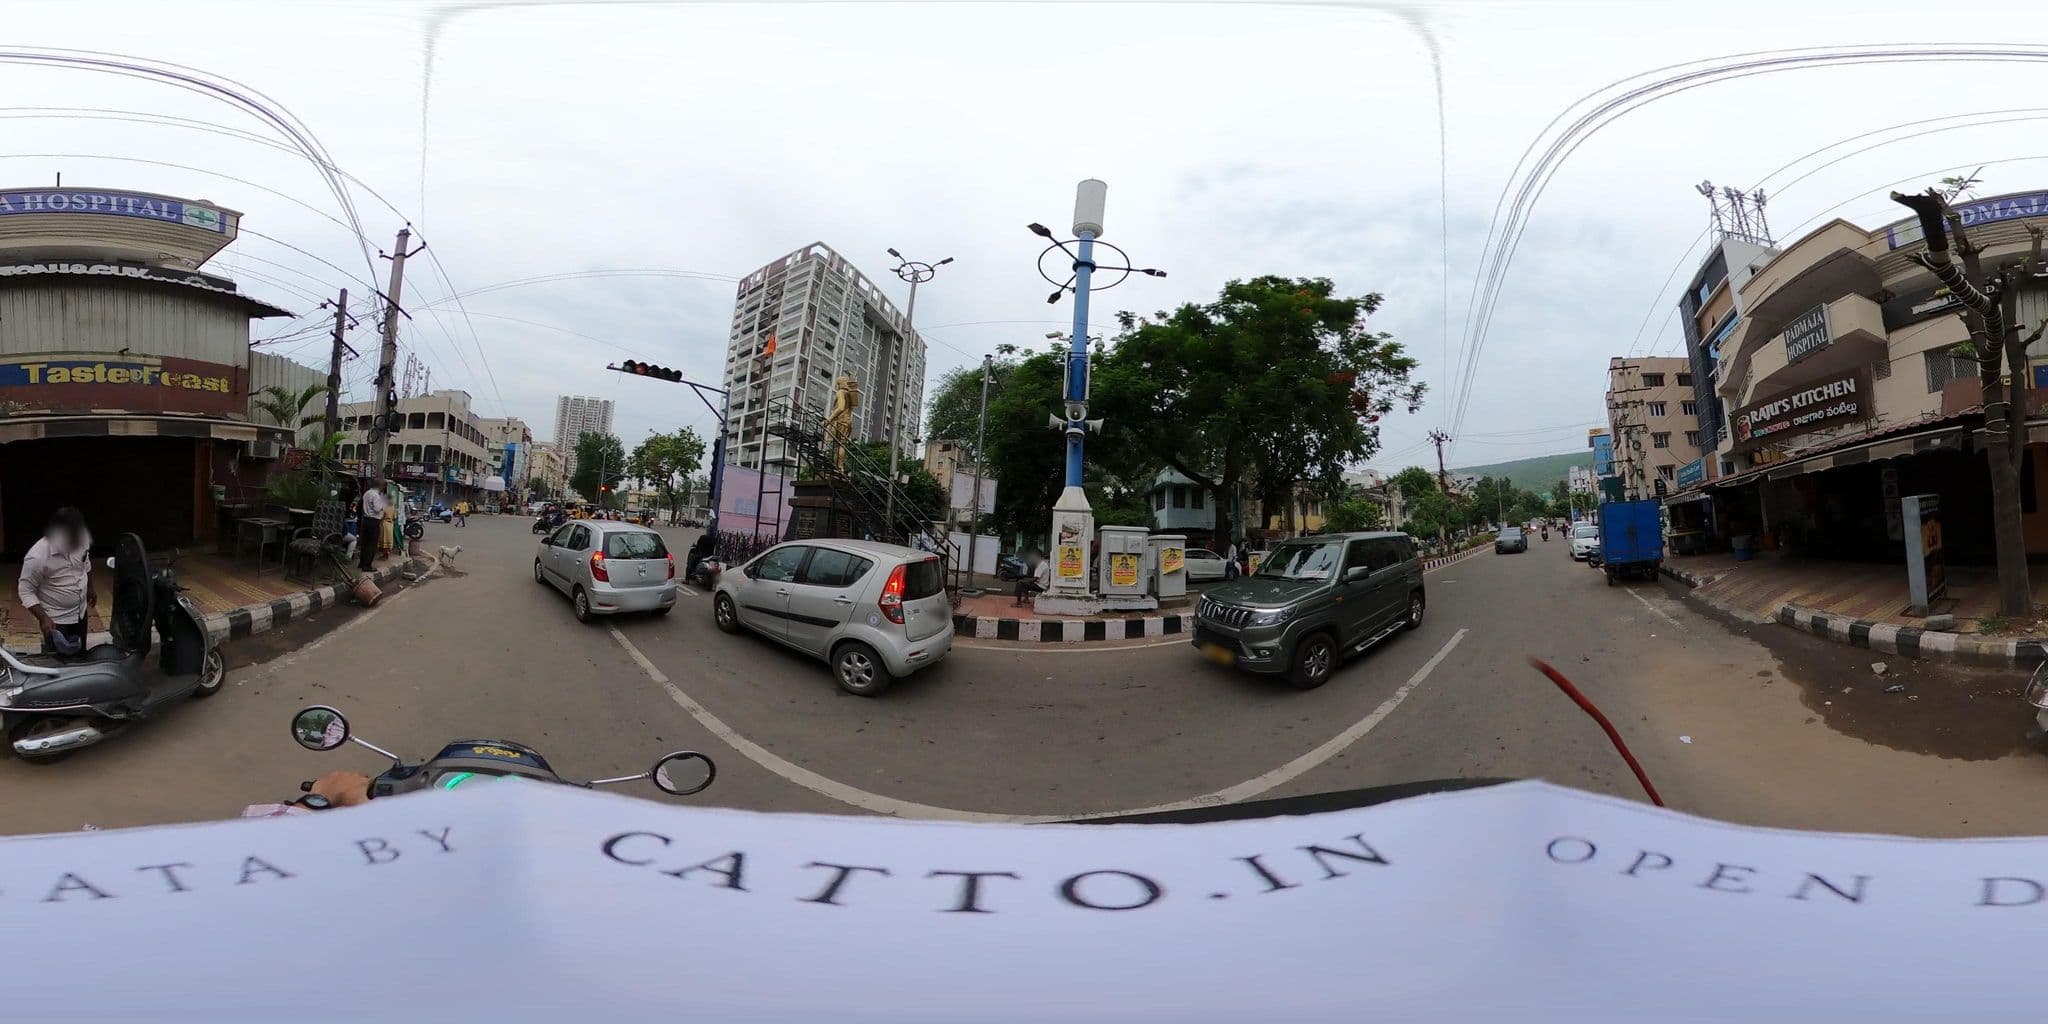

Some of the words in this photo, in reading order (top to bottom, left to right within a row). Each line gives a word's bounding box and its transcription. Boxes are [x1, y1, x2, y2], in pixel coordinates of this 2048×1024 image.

[23, 194, 177, 219] HOSPITAL
[1785, 311, 1824, 343] PADMAJA
[1787, 328, 1828, 360] HOSPITAL
[20, 363, 132, 384] Taste
[1750, 398, 1791, 423] RAJU'S
[1791, 378, 1856, 409] KITCHEN
[355, 826, 456, 865] BY
[601, 830, 1392, 914] CATTO.IN
[1546, 836, 1874, 904] OPEN
